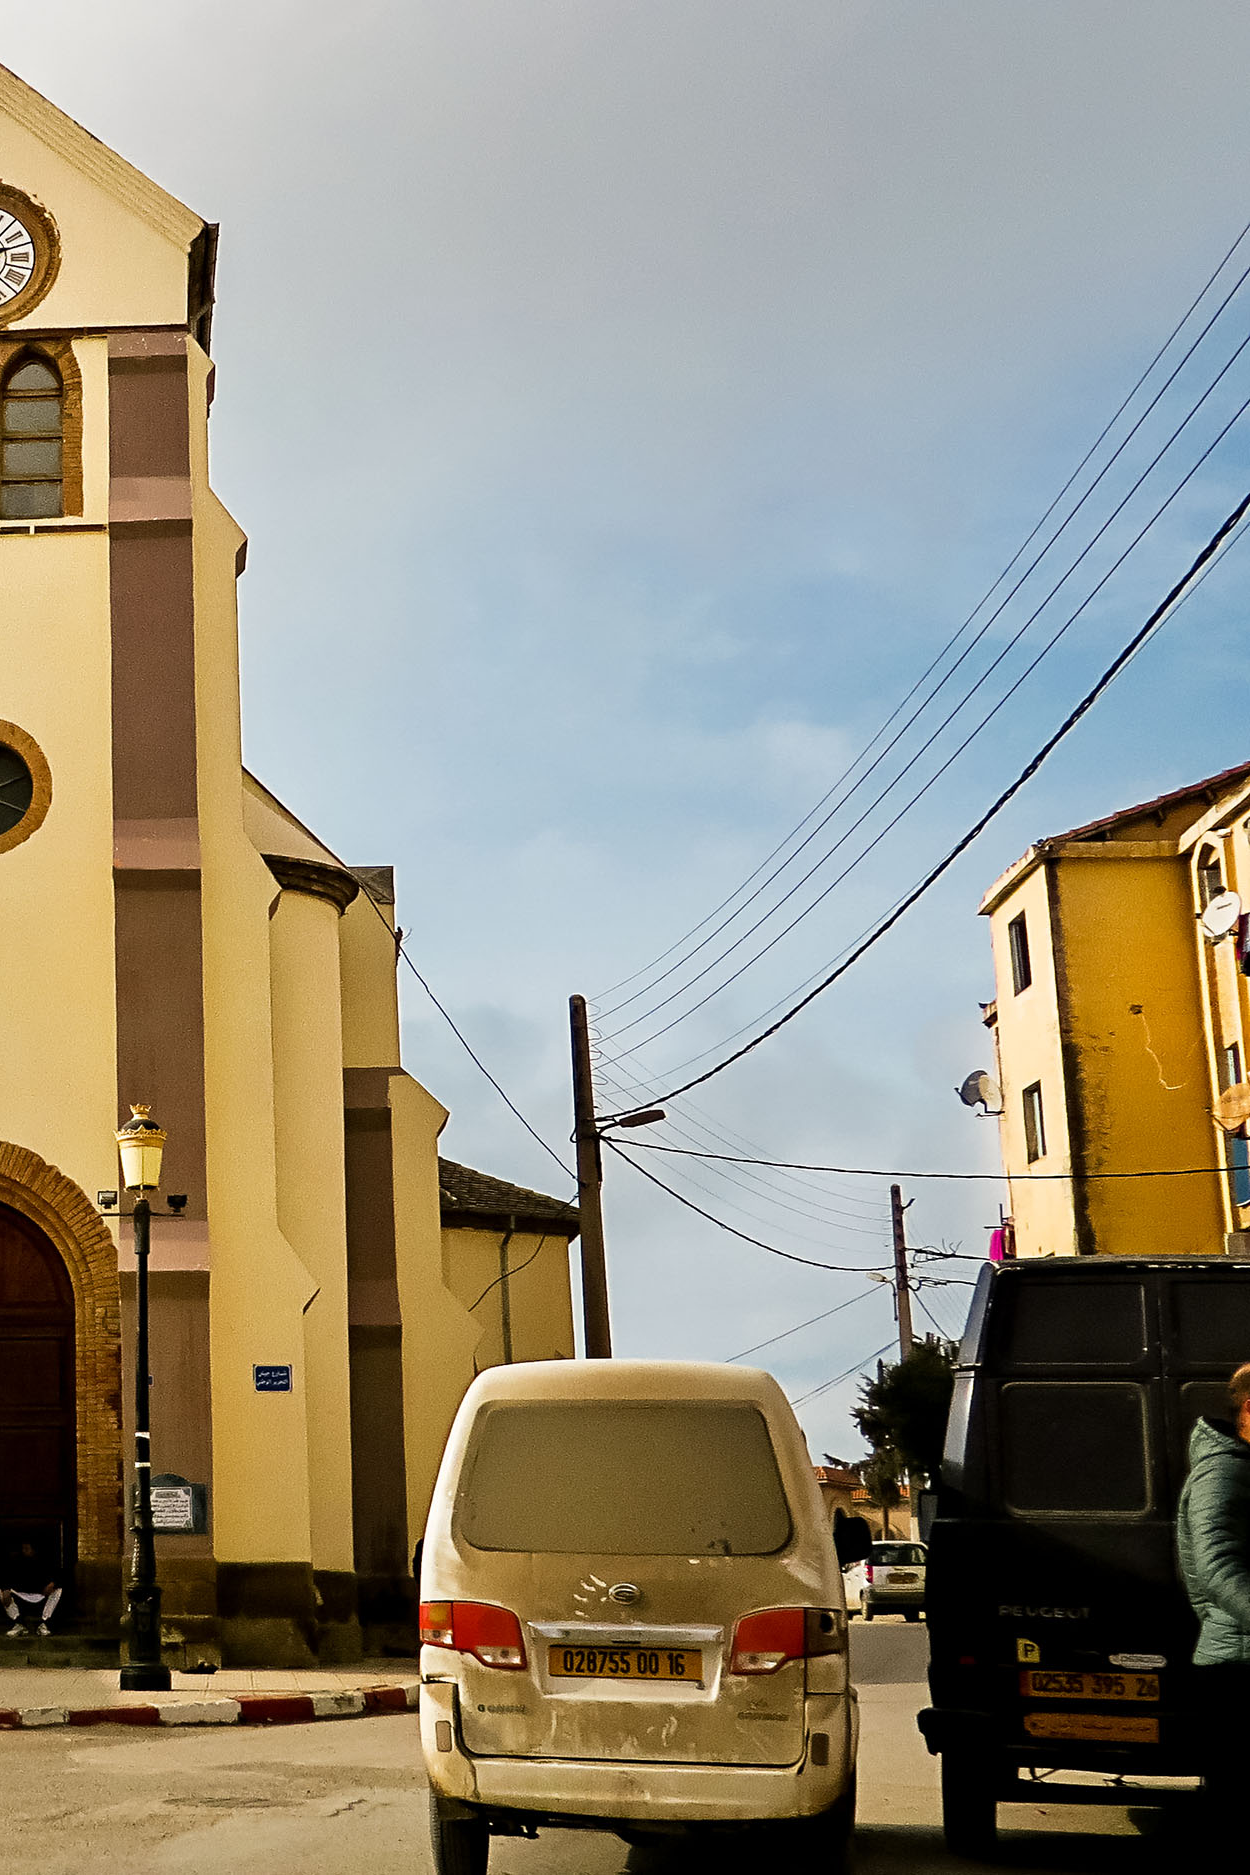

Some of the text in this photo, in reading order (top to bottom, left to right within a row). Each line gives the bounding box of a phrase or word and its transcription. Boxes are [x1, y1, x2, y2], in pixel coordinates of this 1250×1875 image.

[5, 230, 24, 244] II
[10, 251, 29, 263] III
[998, 1604, 1090, 1619] PEUGEOT
[563, 1650, 686, 1676] 028755 00 16
[1136, 1677, 1159, 1698] 26
